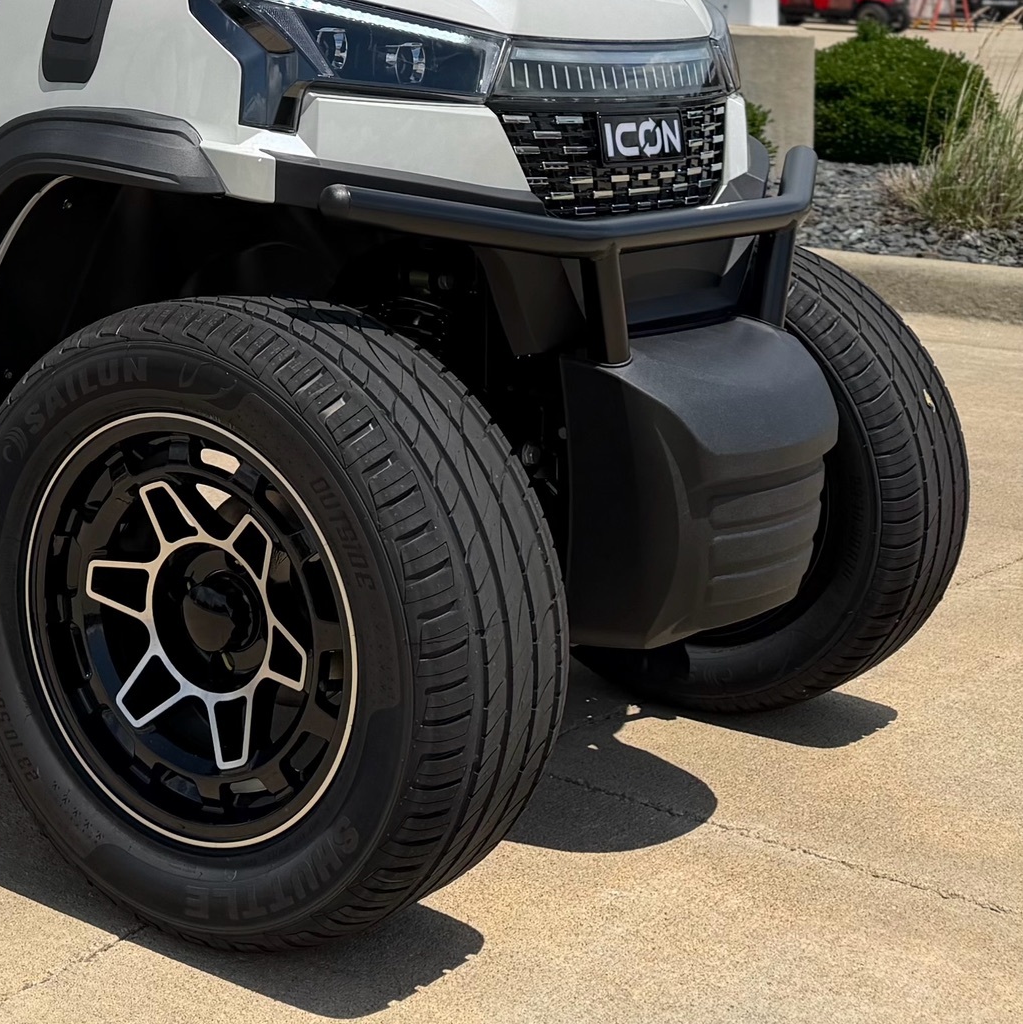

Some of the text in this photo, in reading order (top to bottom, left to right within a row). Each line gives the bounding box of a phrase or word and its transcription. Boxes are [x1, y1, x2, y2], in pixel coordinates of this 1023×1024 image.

[604, 117, 681, 157] ICON
[25, 356, 148, 433] SAILUN
[310, 477, 376, 591] OUTSIDE
[184, 815, 360, 920] SHUTTLE
